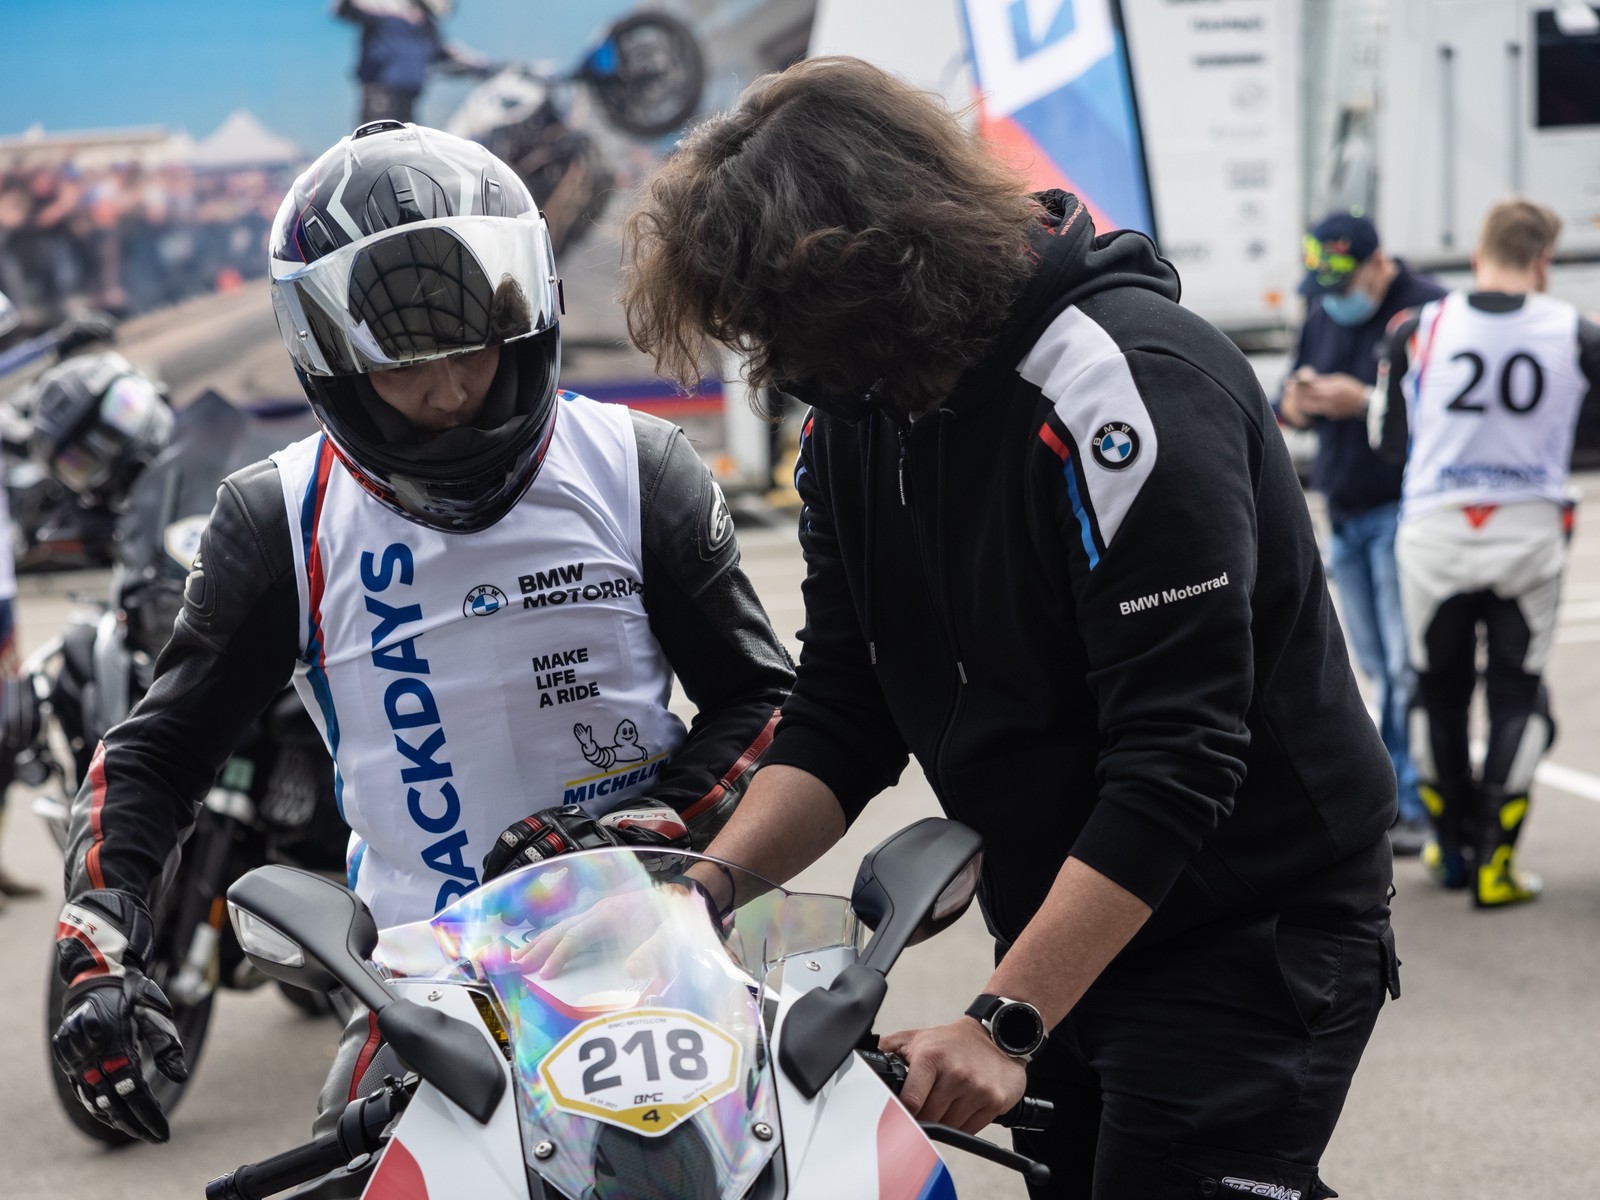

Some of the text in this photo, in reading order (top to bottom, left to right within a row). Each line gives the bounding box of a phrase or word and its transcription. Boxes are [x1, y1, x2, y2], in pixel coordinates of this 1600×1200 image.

[1446, 352, 1545, 415] 20
[517, 562, 585, 595] BMW
[1119, 571, 1230, 616] BMW Motorrad
[532, 647, 589, 672] MAKE
[535, 669, 577, 691] LIFE
[539, 681, 601, 709] A RIDE
[578, 1028, 708, 1096] 218
[634, 1092, 664, 1105] BMC
[642, 1109, 661, 1123] 4
